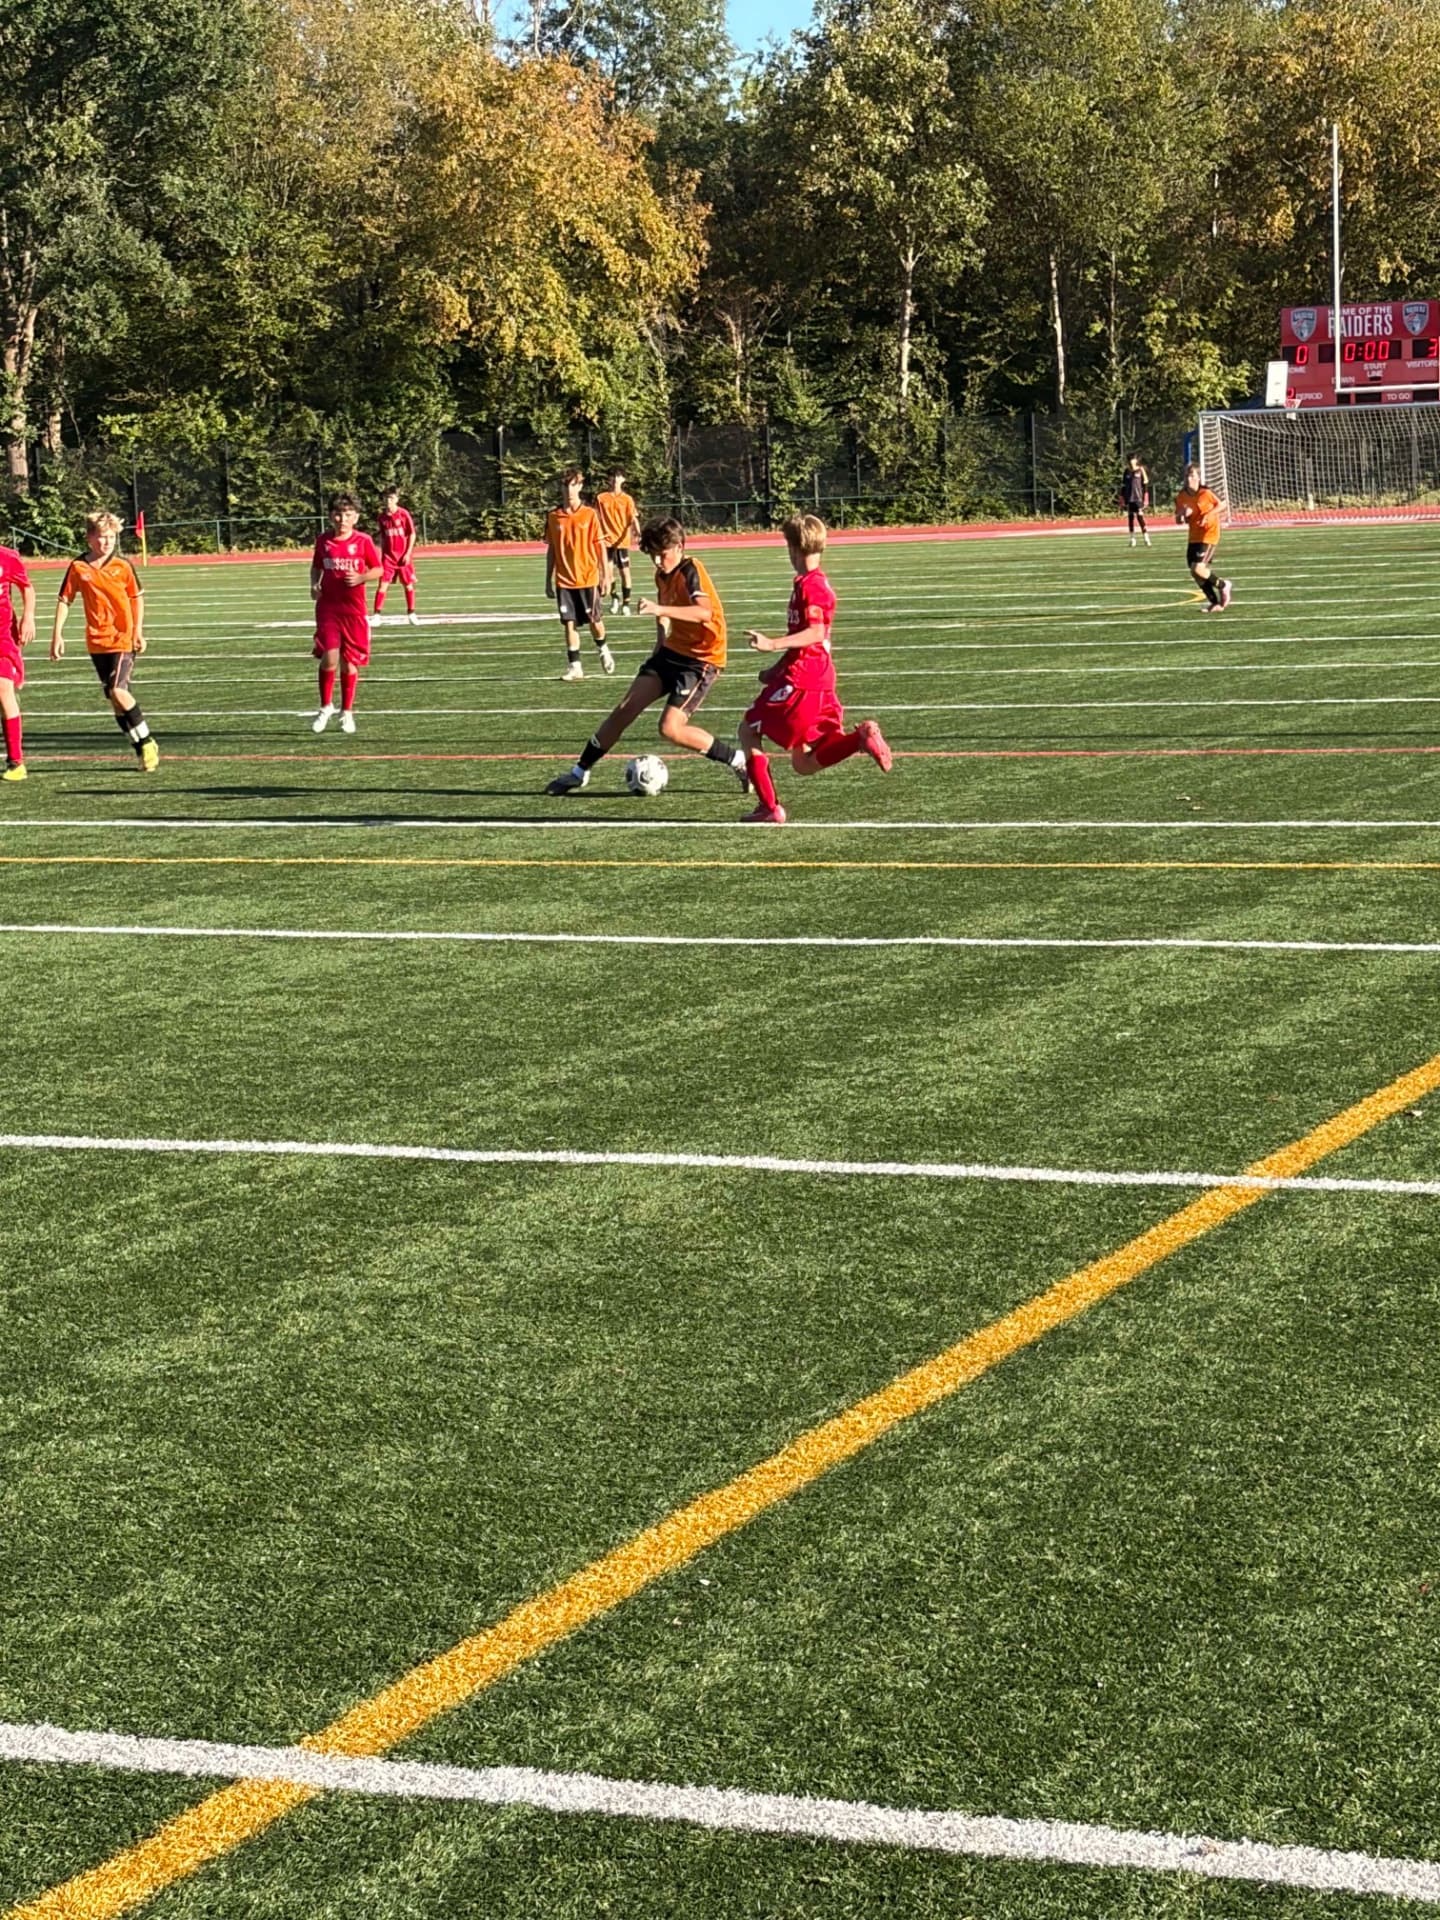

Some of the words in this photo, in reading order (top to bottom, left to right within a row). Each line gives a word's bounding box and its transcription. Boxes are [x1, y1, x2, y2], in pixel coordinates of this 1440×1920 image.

[1328, 307, 1356, 317] HME
[1359, 306, 1372, 315] OF
[1374, 305, 1392, 314] THE
[1295, 345, 1308, 365] 0
[1343, 341, 1390, 362] 0:00
[1363, 362, 1387, 370] START
[1386, 393, 1397, 401] TO
[1398, 391, 1411, 400] GO
